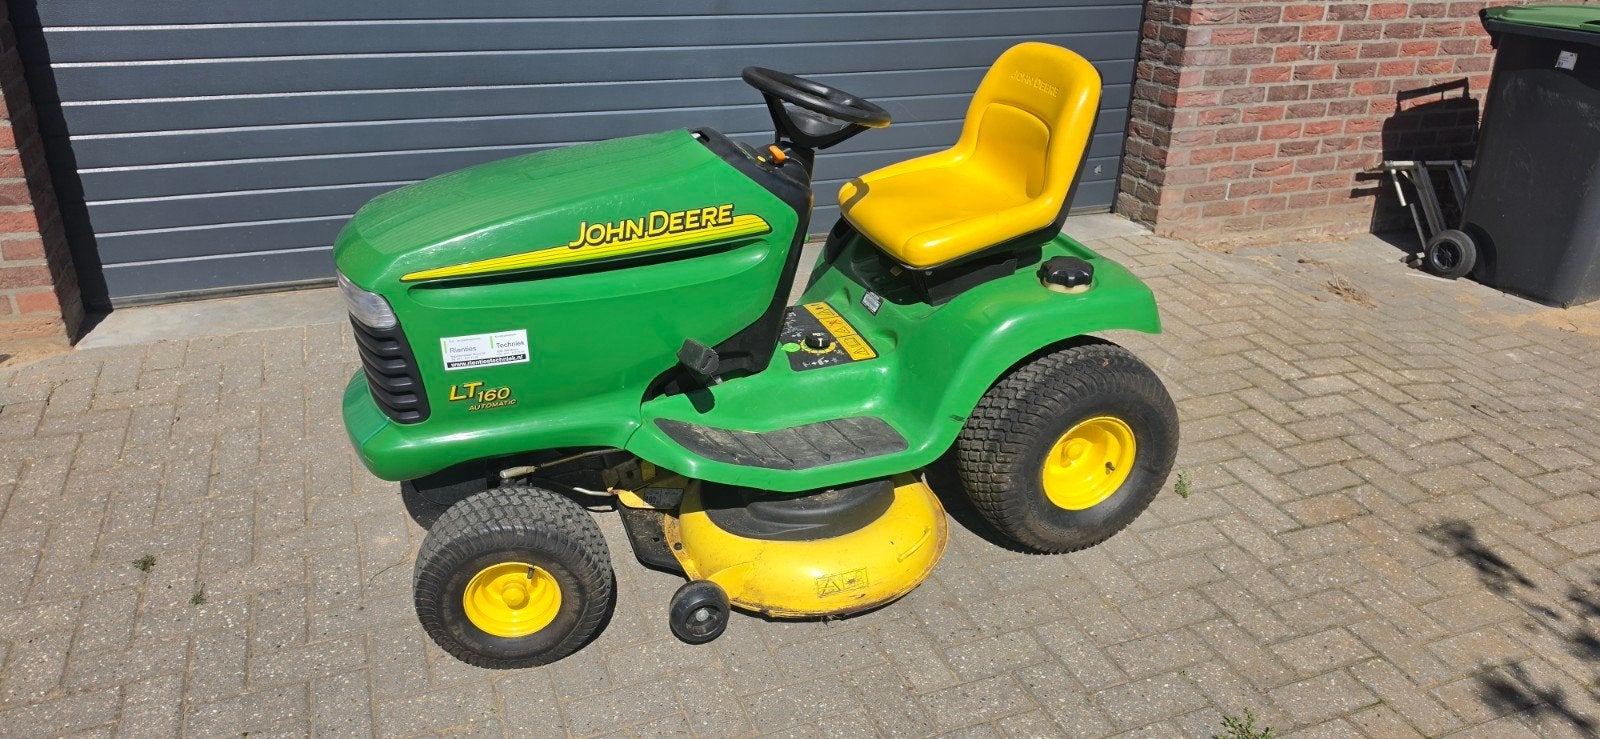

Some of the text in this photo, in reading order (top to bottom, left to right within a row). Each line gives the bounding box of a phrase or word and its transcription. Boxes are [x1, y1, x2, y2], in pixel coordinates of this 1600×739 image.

[1034, 77, 1060, 98] DEERE
[568, 203, 735, 249] JOHN DEERE
[496, 341, 525, 349] Techniek
[449, 381, 512, 403] LT 160
[468, 399, 517, 411] AUTOMATIC
